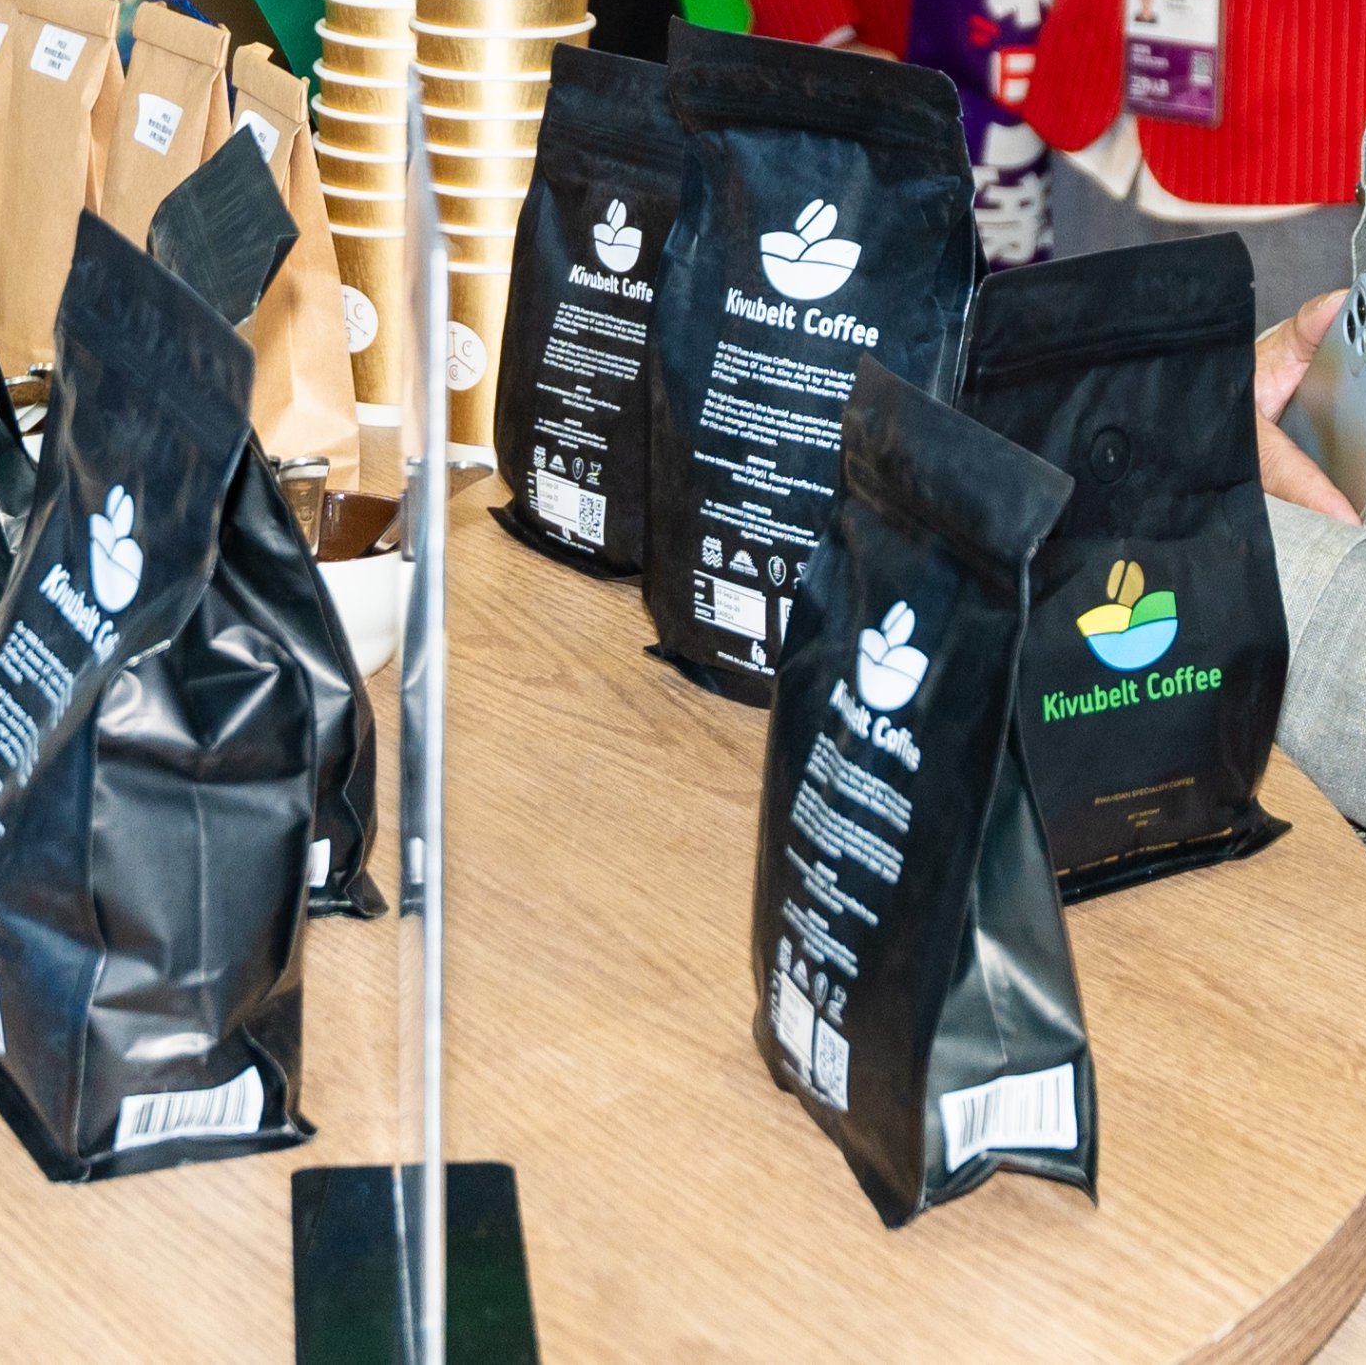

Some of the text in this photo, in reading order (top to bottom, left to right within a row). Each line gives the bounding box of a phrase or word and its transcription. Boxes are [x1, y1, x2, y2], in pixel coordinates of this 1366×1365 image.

[568, 263, 619, 295] Kivubelt
[725, 287, 879, 348] Kivubelt Coffee
[1043, 665, 1223, 722] Kivubelt Coffee
